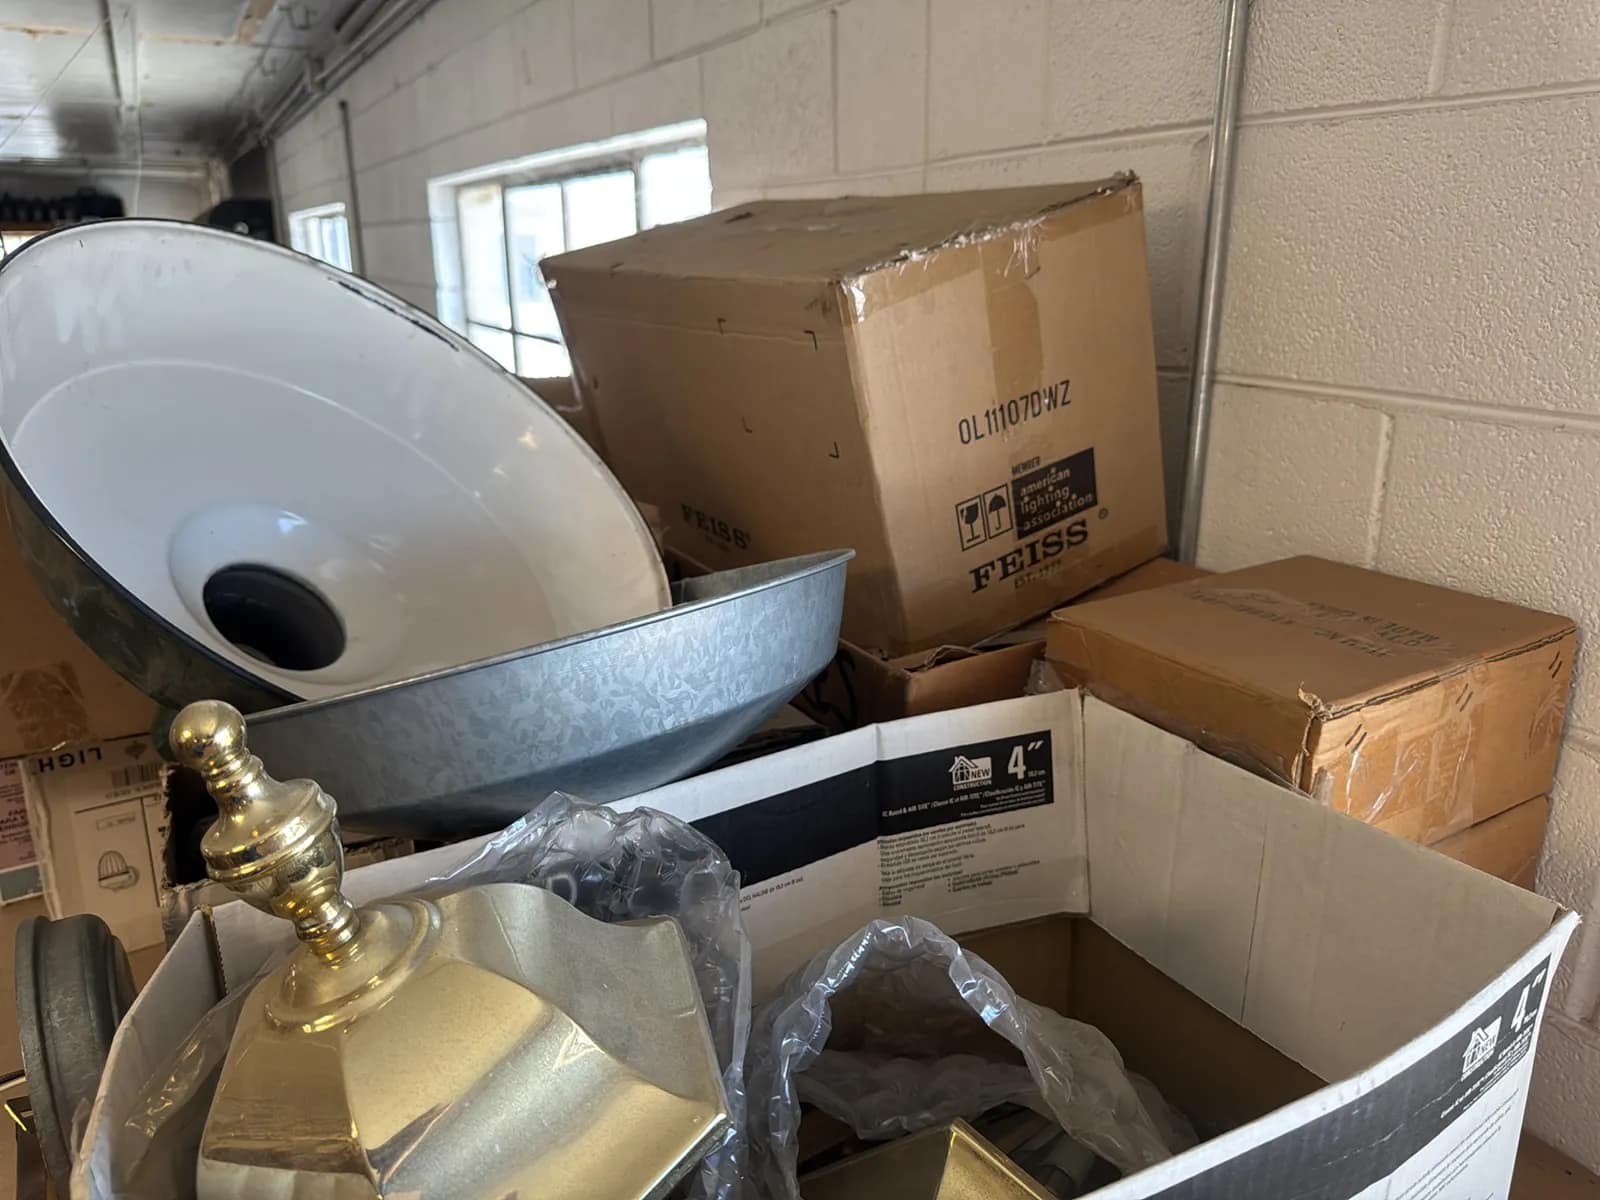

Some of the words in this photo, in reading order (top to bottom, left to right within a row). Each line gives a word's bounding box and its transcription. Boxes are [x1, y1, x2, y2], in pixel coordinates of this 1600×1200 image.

[1020, 467, 1071, 497] american
[1020, 486, 1071, 514] lighting
[1023, 494, 1093, 530] association
[969, 518, 1088, 594] FEISS
[971, 767, 990, 778] NEW
